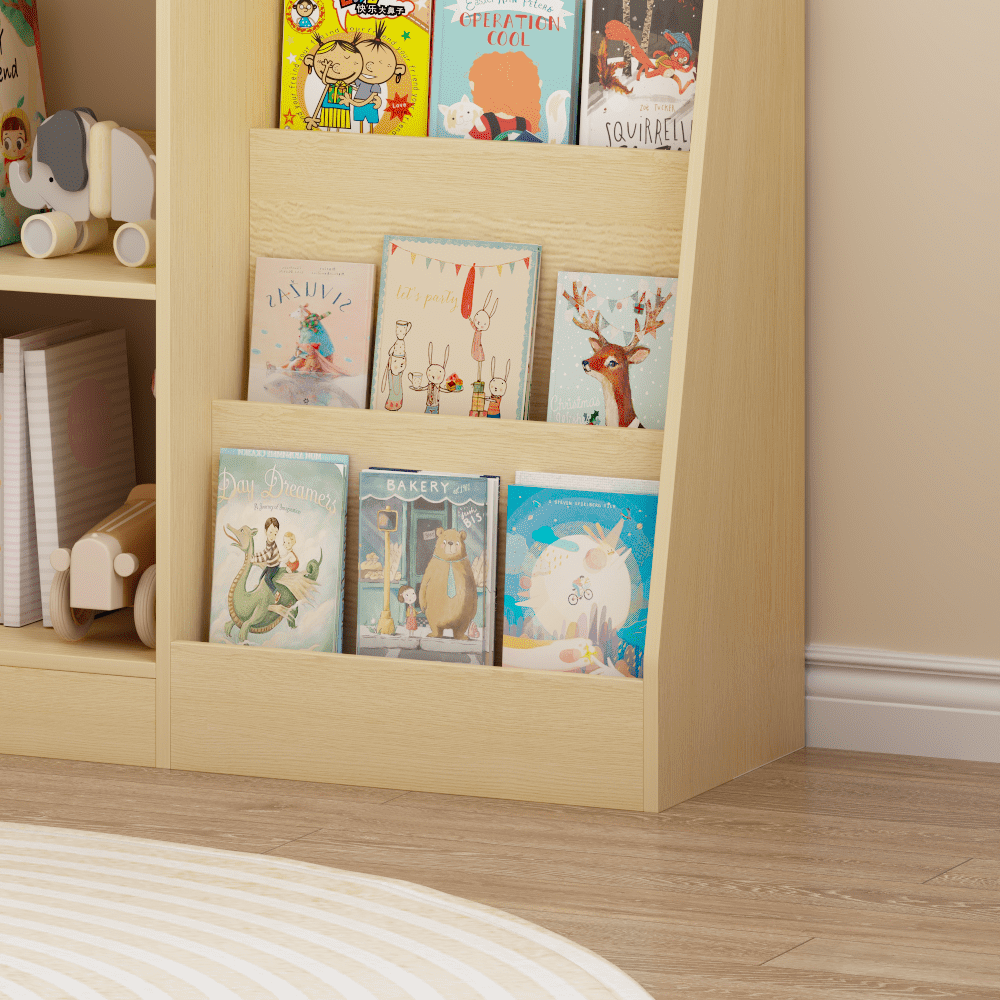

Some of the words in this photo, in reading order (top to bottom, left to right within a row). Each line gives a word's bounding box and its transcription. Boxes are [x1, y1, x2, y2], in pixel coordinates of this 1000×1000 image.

[356, 4, 405, 16] 快乐大鼻子
[459, 11, 560, 32] OPERATION
[487, 30, 531, 47] COOL
[422, 289, 459, 313] party
[217, 467, 254, 504] Day
[261, 464, 337, 514] Dreamers
[386, 479, 450, 494] BAKERY
